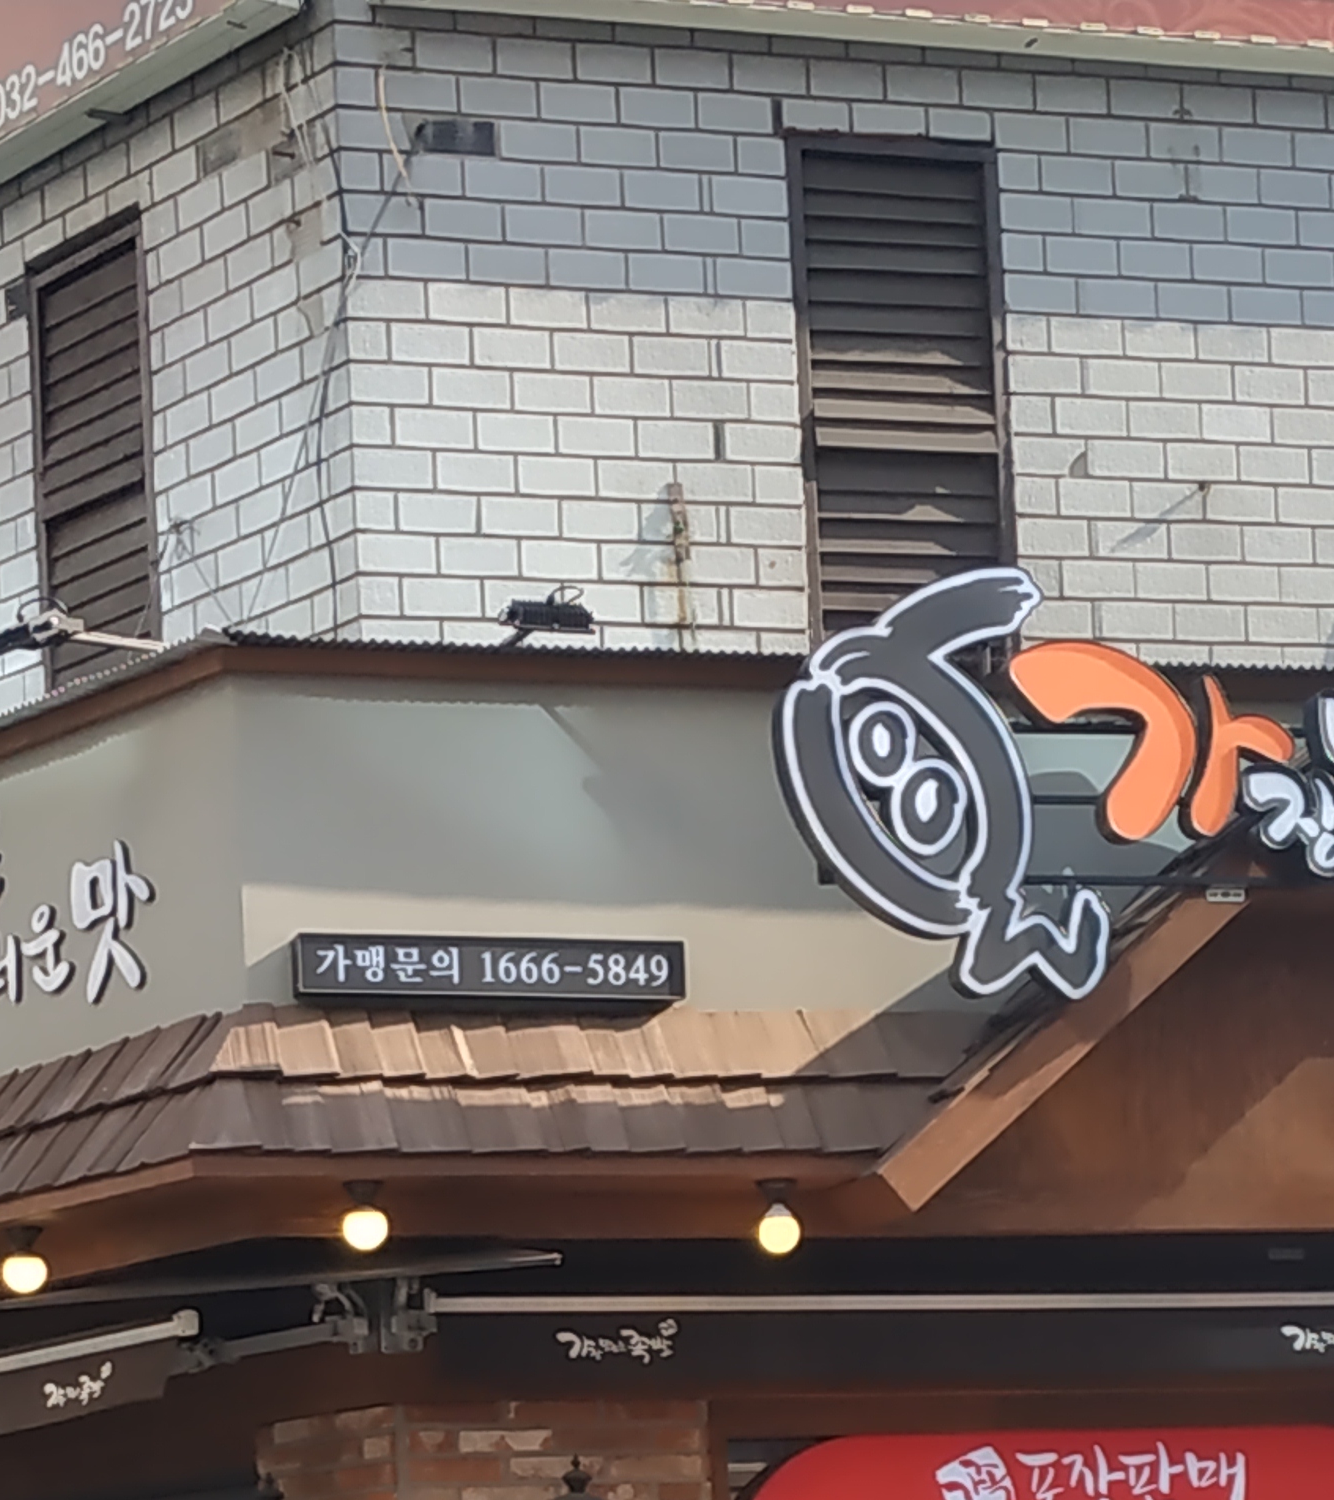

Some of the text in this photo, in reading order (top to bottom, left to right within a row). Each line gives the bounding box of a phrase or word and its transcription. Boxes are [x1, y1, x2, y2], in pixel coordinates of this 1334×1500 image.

[69, 840, 157, 1003] 맛
[315, 943, 670, 987] 가맹문의 1666-5849
